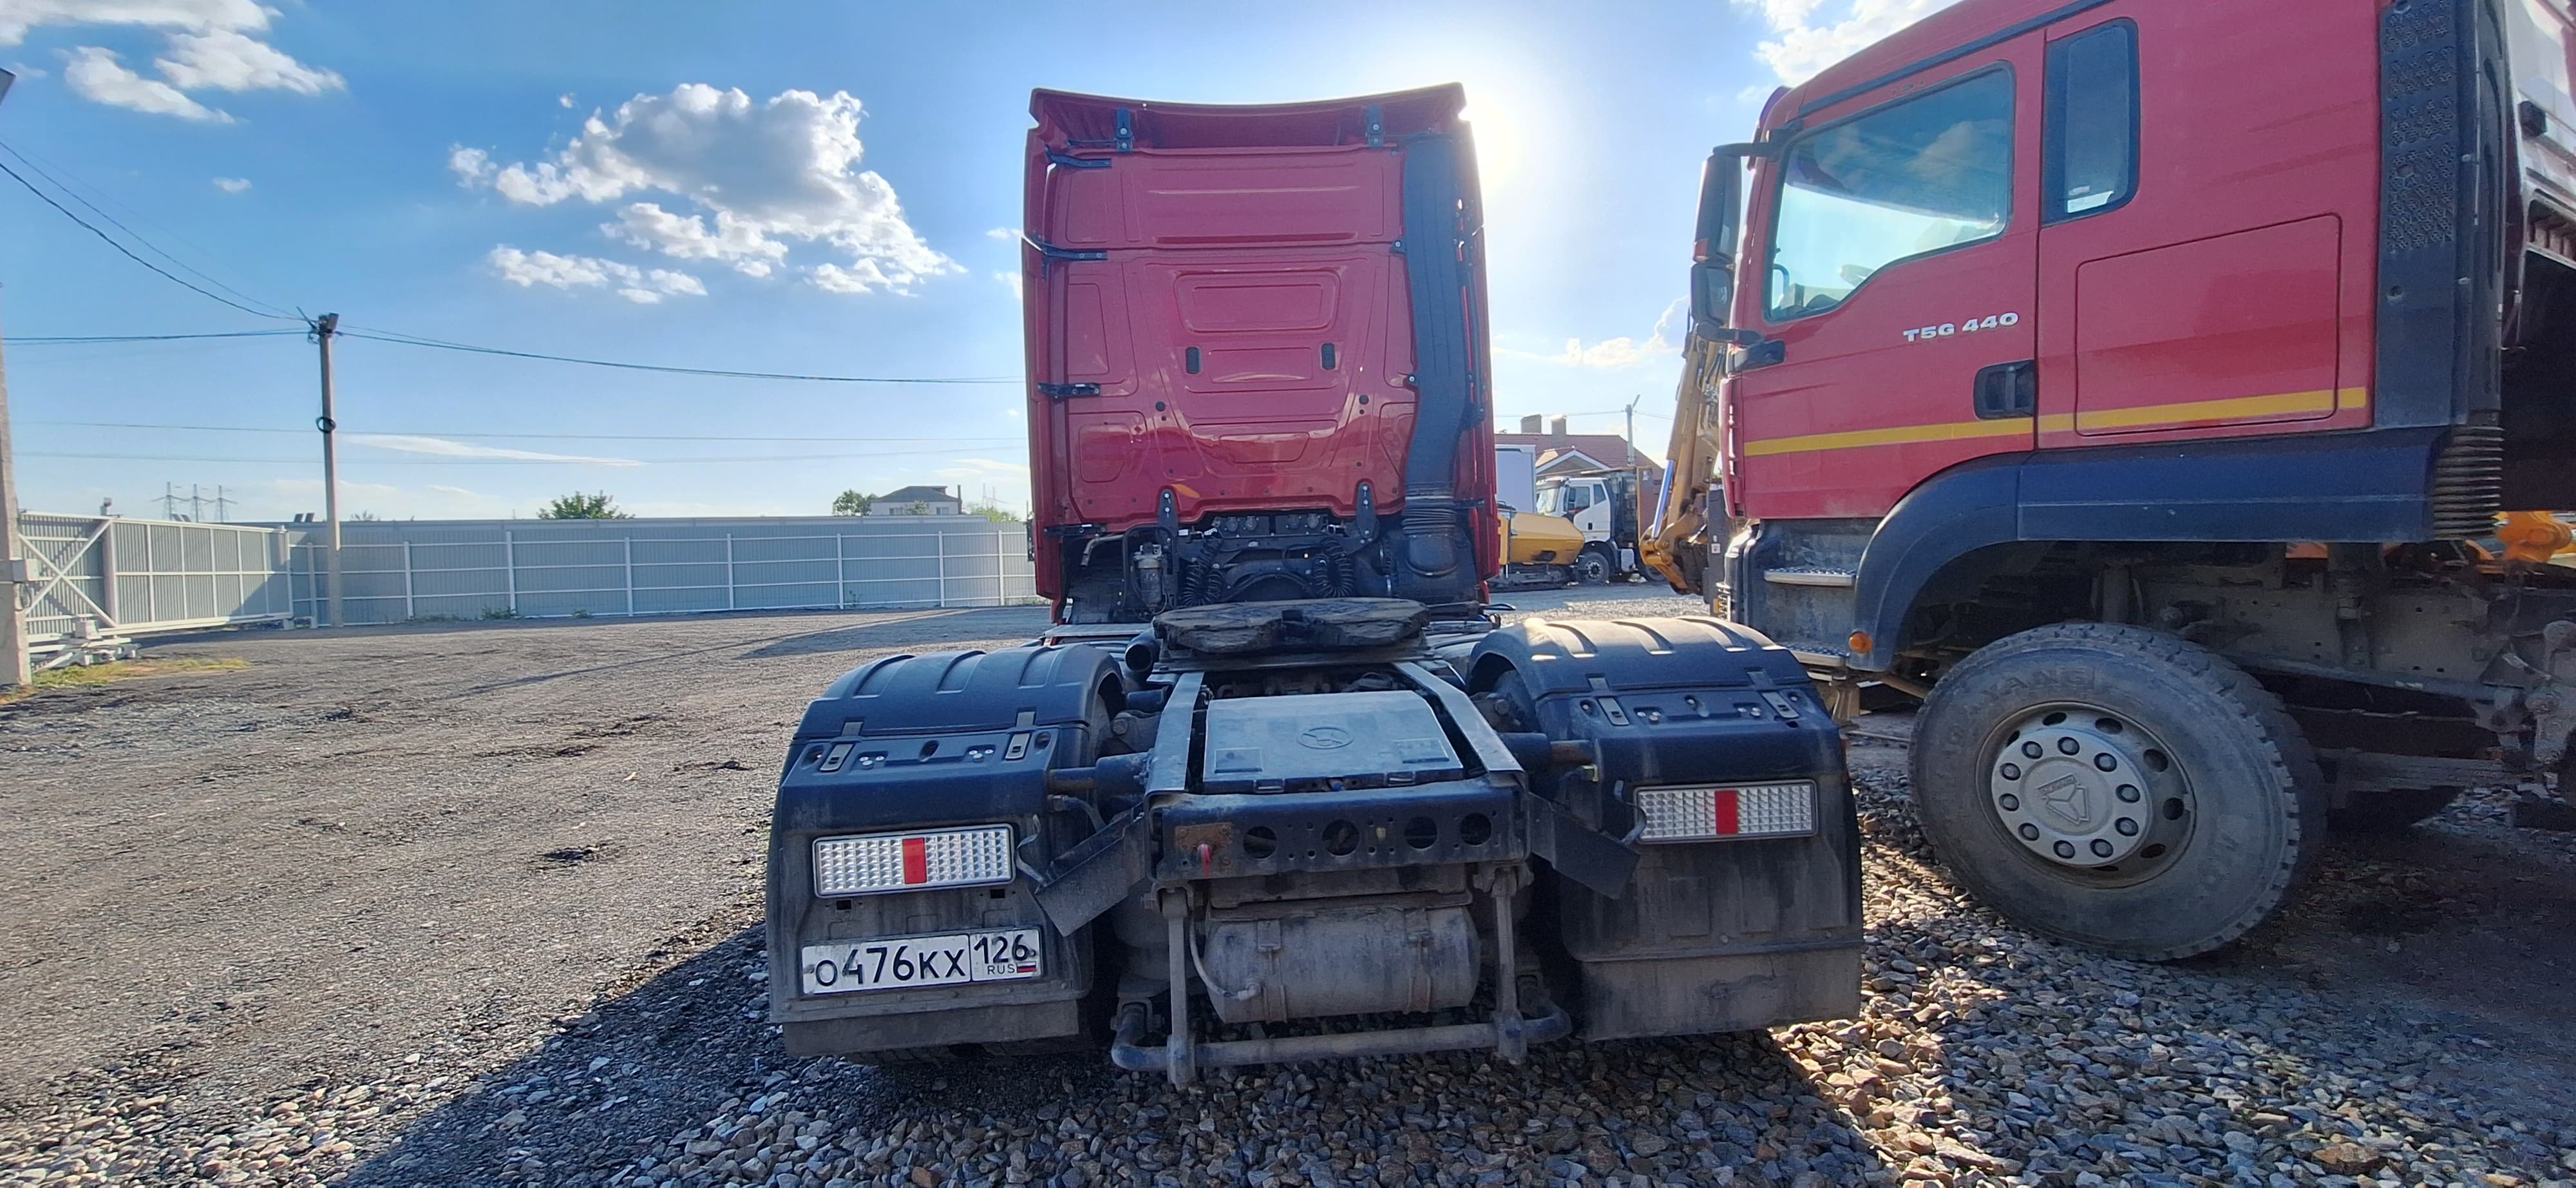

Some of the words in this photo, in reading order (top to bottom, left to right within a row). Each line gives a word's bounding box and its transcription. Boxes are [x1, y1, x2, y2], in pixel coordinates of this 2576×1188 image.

[1903, 323, 1955, 342] T5G
[1962, 312, 2019, 332] 440
[973, 934, 1030, 964] 126
[987, 964, 1016, 975] RUS
